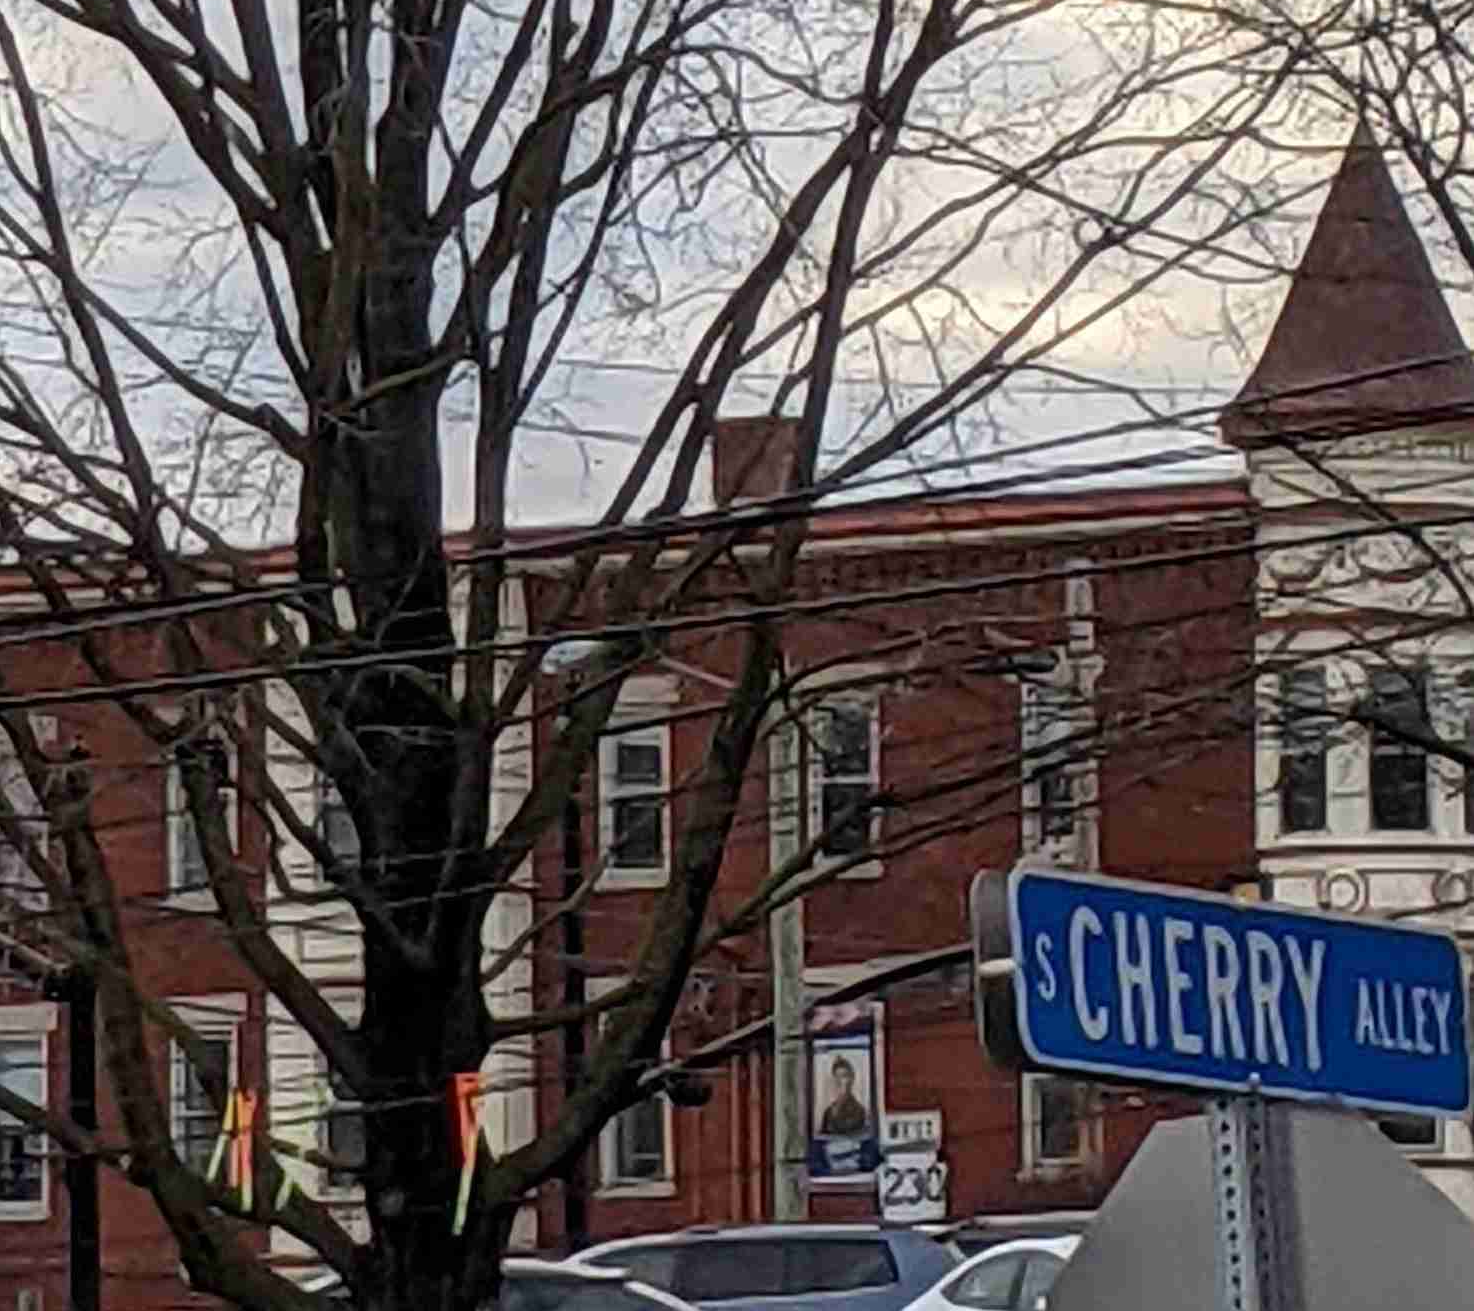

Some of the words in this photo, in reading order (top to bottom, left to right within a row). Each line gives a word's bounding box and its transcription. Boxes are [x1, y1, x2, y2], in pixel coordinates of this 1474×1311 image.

[1034, 932, 1057, 1002] S
[1069, 905, 1326, 1072] CHERRY
[1355, 978, 1452, 1056] ALLEY
[884, 1166, 943, 1206] 230
